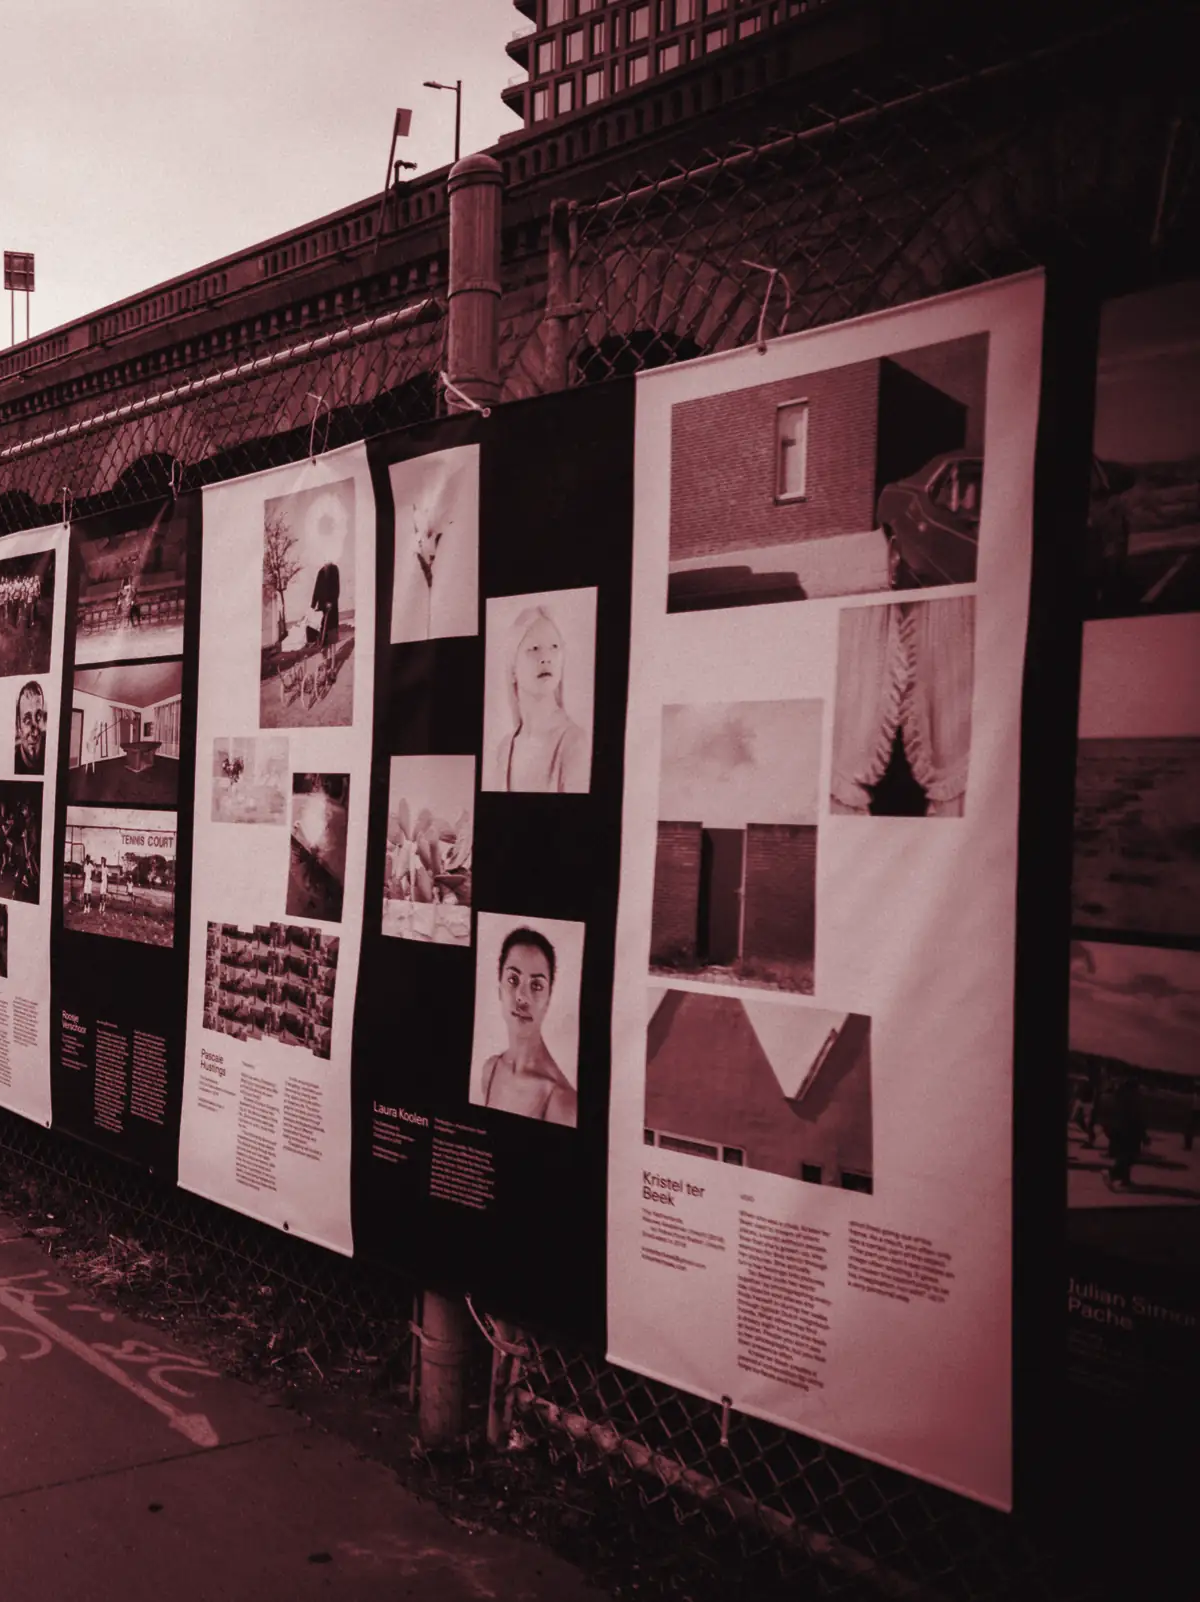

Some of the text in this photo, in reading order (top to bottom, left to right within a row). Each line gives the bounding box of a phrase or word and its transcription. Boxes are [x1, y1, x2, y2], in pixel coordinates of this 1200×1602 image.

[121, 834, 174, 849] TENNIS COURT
[373, 1100, 429, 1128] Laura Koolen
[643, 1170, 706, 1198] Kristel ter
[643, 1185, 676, 1208] Beek
[1067, 1277, 1125, 1308] Julian
[1068, 1295, 1134, 1331] Pache
